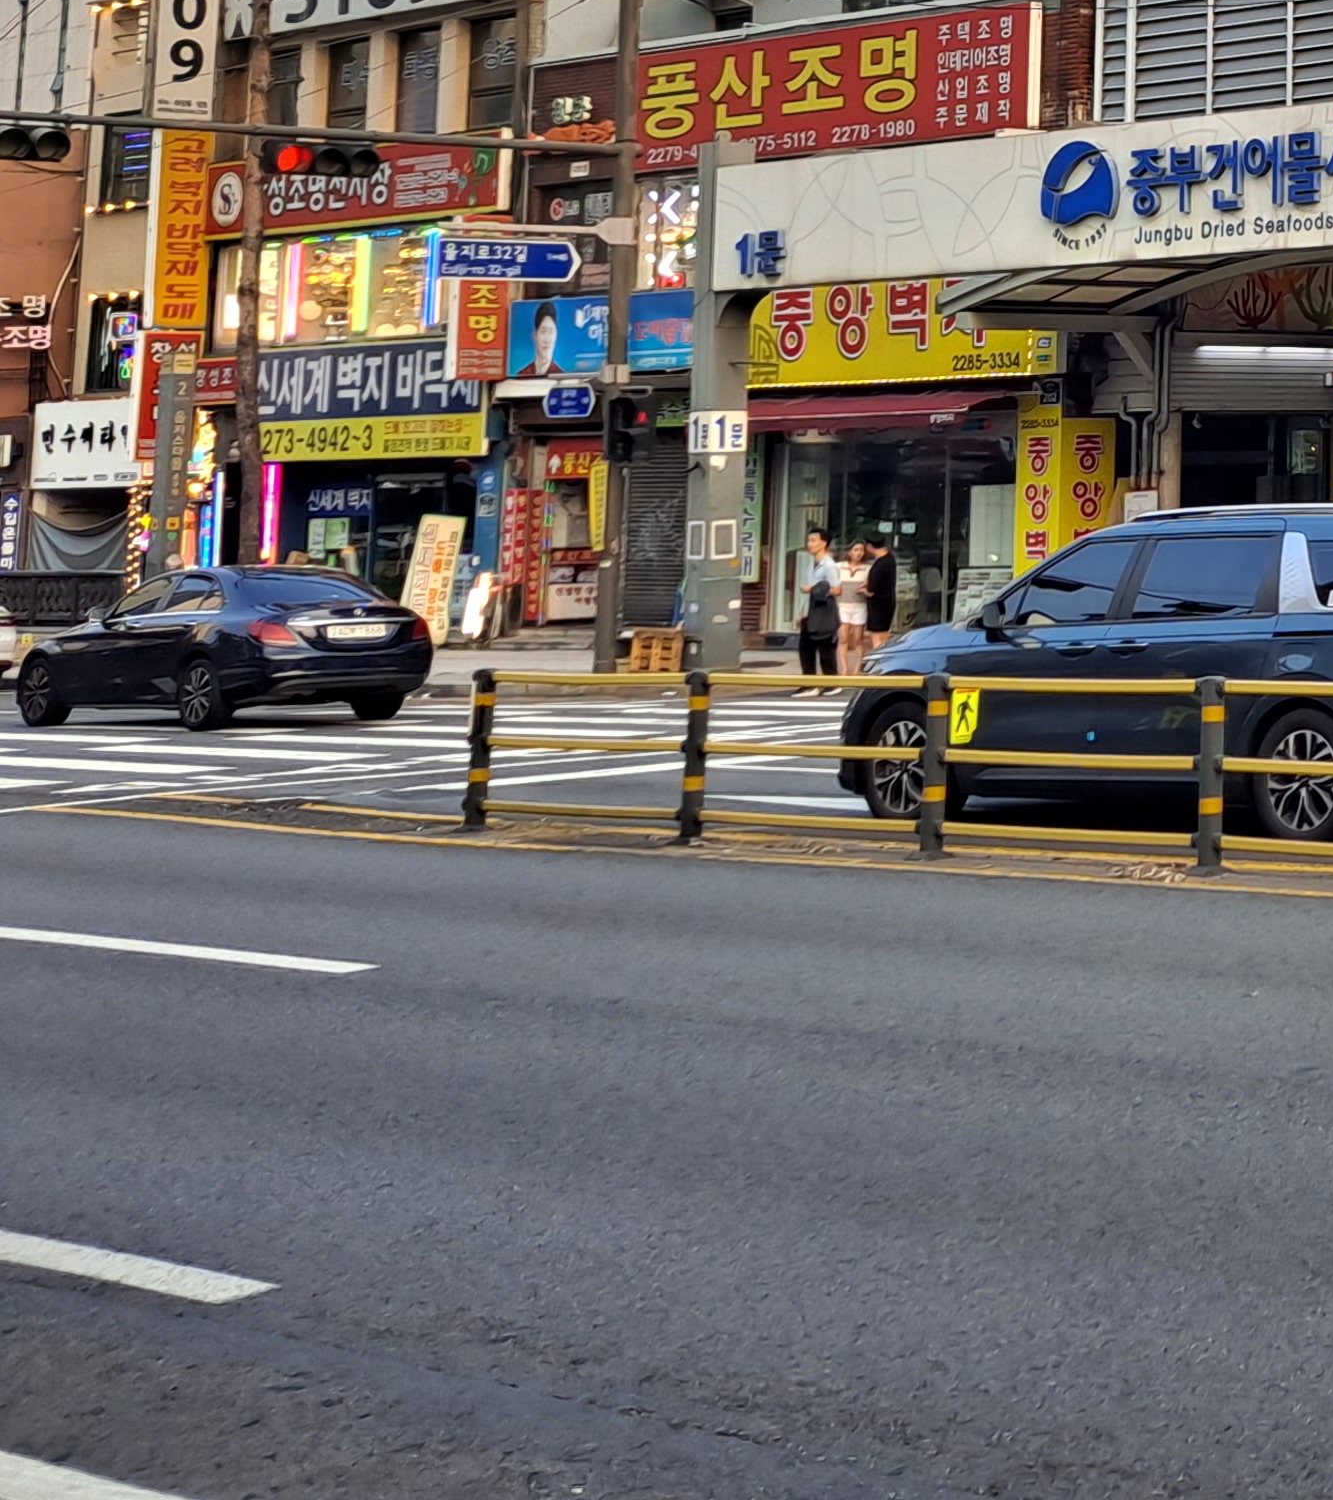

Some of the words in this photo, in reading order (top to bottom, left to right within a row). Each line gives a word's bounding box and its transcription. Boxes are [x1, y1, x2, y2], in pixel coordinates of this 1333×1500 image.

[937, 43, 1012, 74] 인테리어조명
[641, 28, 920, 140] 풍산조명
[832, 119, 916, 144] 2278-1980
[1051, 227, 1081, 251] SINCE
[1134, 225, 1194, 246] Jungbu
[1200, 215, 1246, 239] Dried
[442, 244, 528, 263] 을지로32길
[735, 229, 787, 278] 1문
[161, 283, 199, 320] 도매
[466, 284, 501, 343] 조명
[952, 352, 1020, 371] 2285-3334
[257, 353, 332, 415] 신세계
[336, 350, 392, 412] 벽지
[715, 414, 743, 450] 1문
